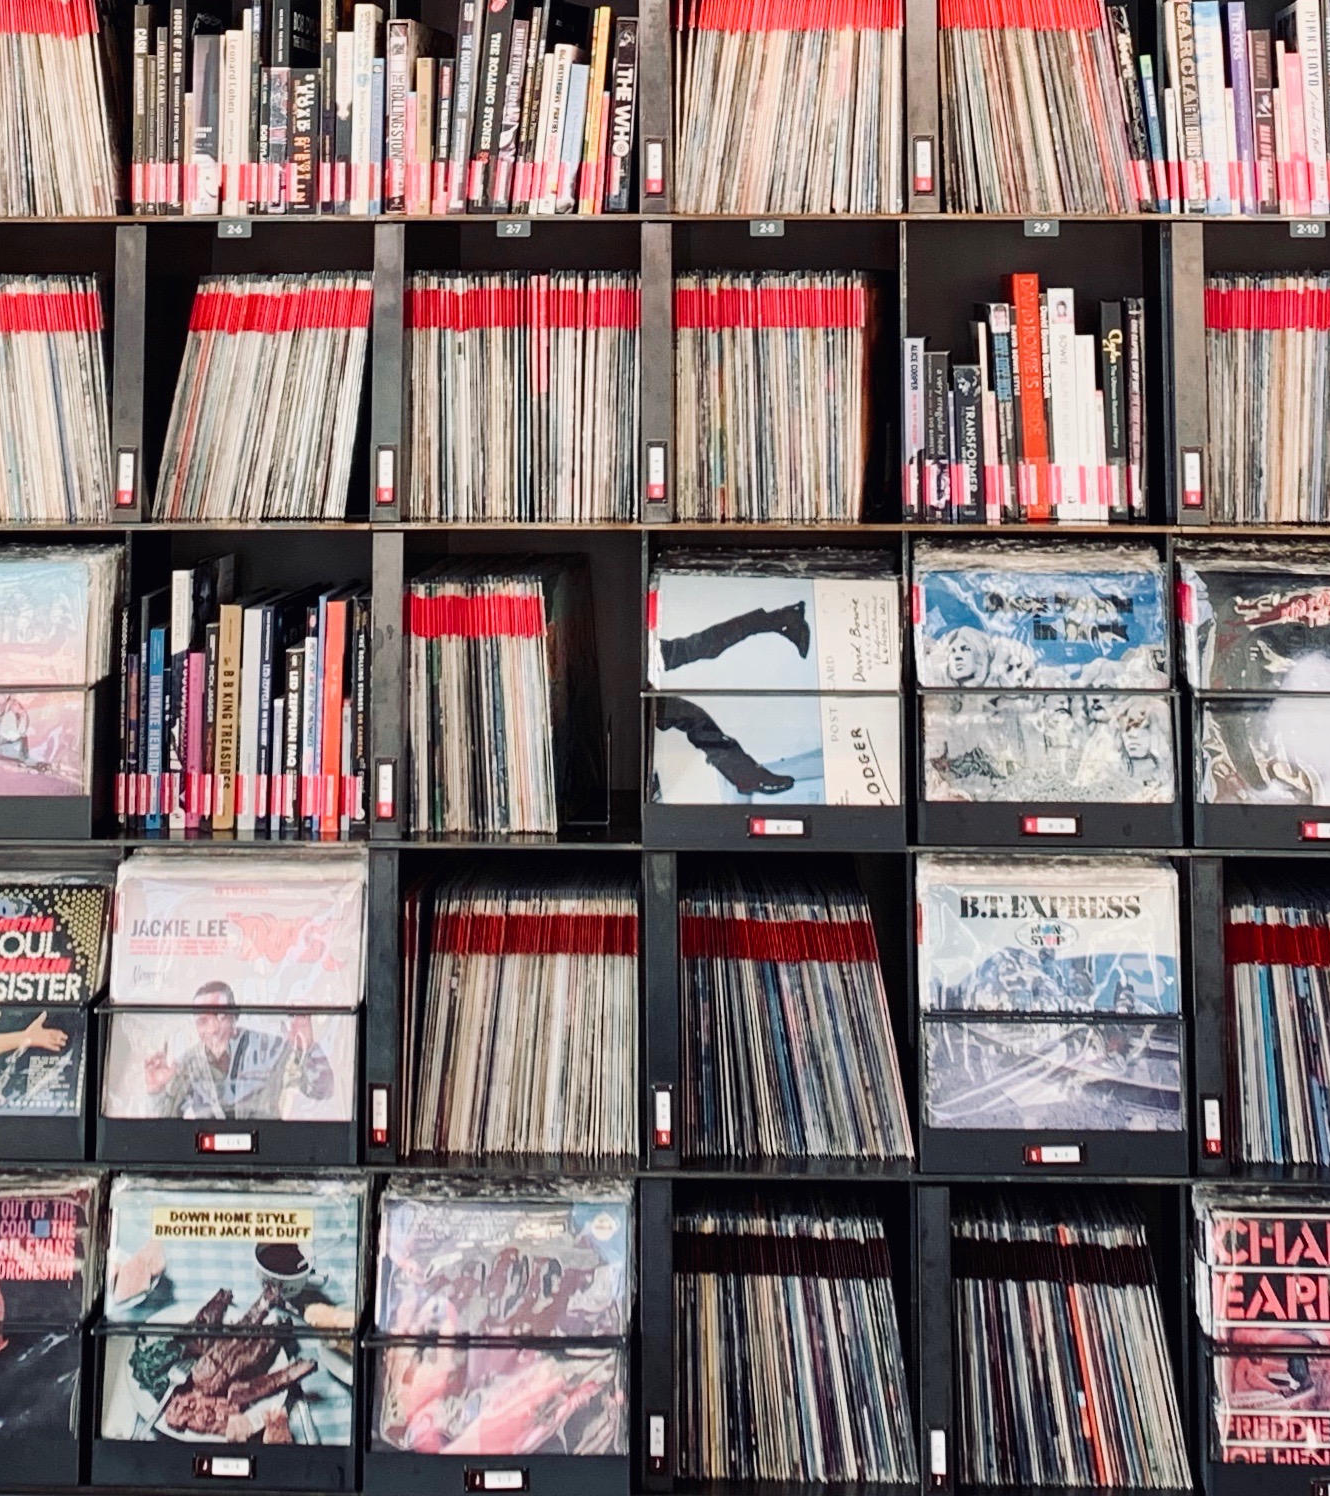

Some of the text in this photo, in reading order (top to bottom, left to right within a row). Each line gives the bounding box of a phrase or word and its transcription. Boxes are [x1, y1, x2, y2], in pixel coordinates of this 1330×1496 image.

[135, 28, 147, 54] CASH
[173, 9, 182, 73] HOUSE OF CASH
[1177, 4, 1197, 105] GARCIA
[1304, 11, 1319, 86] PINK FLOYD
[228, 39, 238, 114] Leonard Cohen
[459, 35, 472, 112] THE ROLLING STONES
[480, 32, 501, 149] THE ROLLING STONES
[612, 69, 633, 157] THE WHO
[910, 345, 918, 391] ALICE COOPER
[935, 376, 945, 396] very
[935, 398, 945, 431] irregular
[937, 434, 946, 455] head
[965, 406, 978, 493] TRANSFORMER
[222, 692, 233, 718] KING
[286, 671, 299, 767] LED ZEPPELIN FAQ
[220, 725, 233, 789] TREASURES
[130, 918, 228, 938] JACKIE LEE
[0, 1201, 77, 1220] OUT OF THE
[155, 1225, 216, 1238] BROTHER
[219, 1225, 252, 1238] JACK
[276, 1225, 314, 1239] DUFF
[169, 1210, 297, 1225] DOWN HOME STYLE
